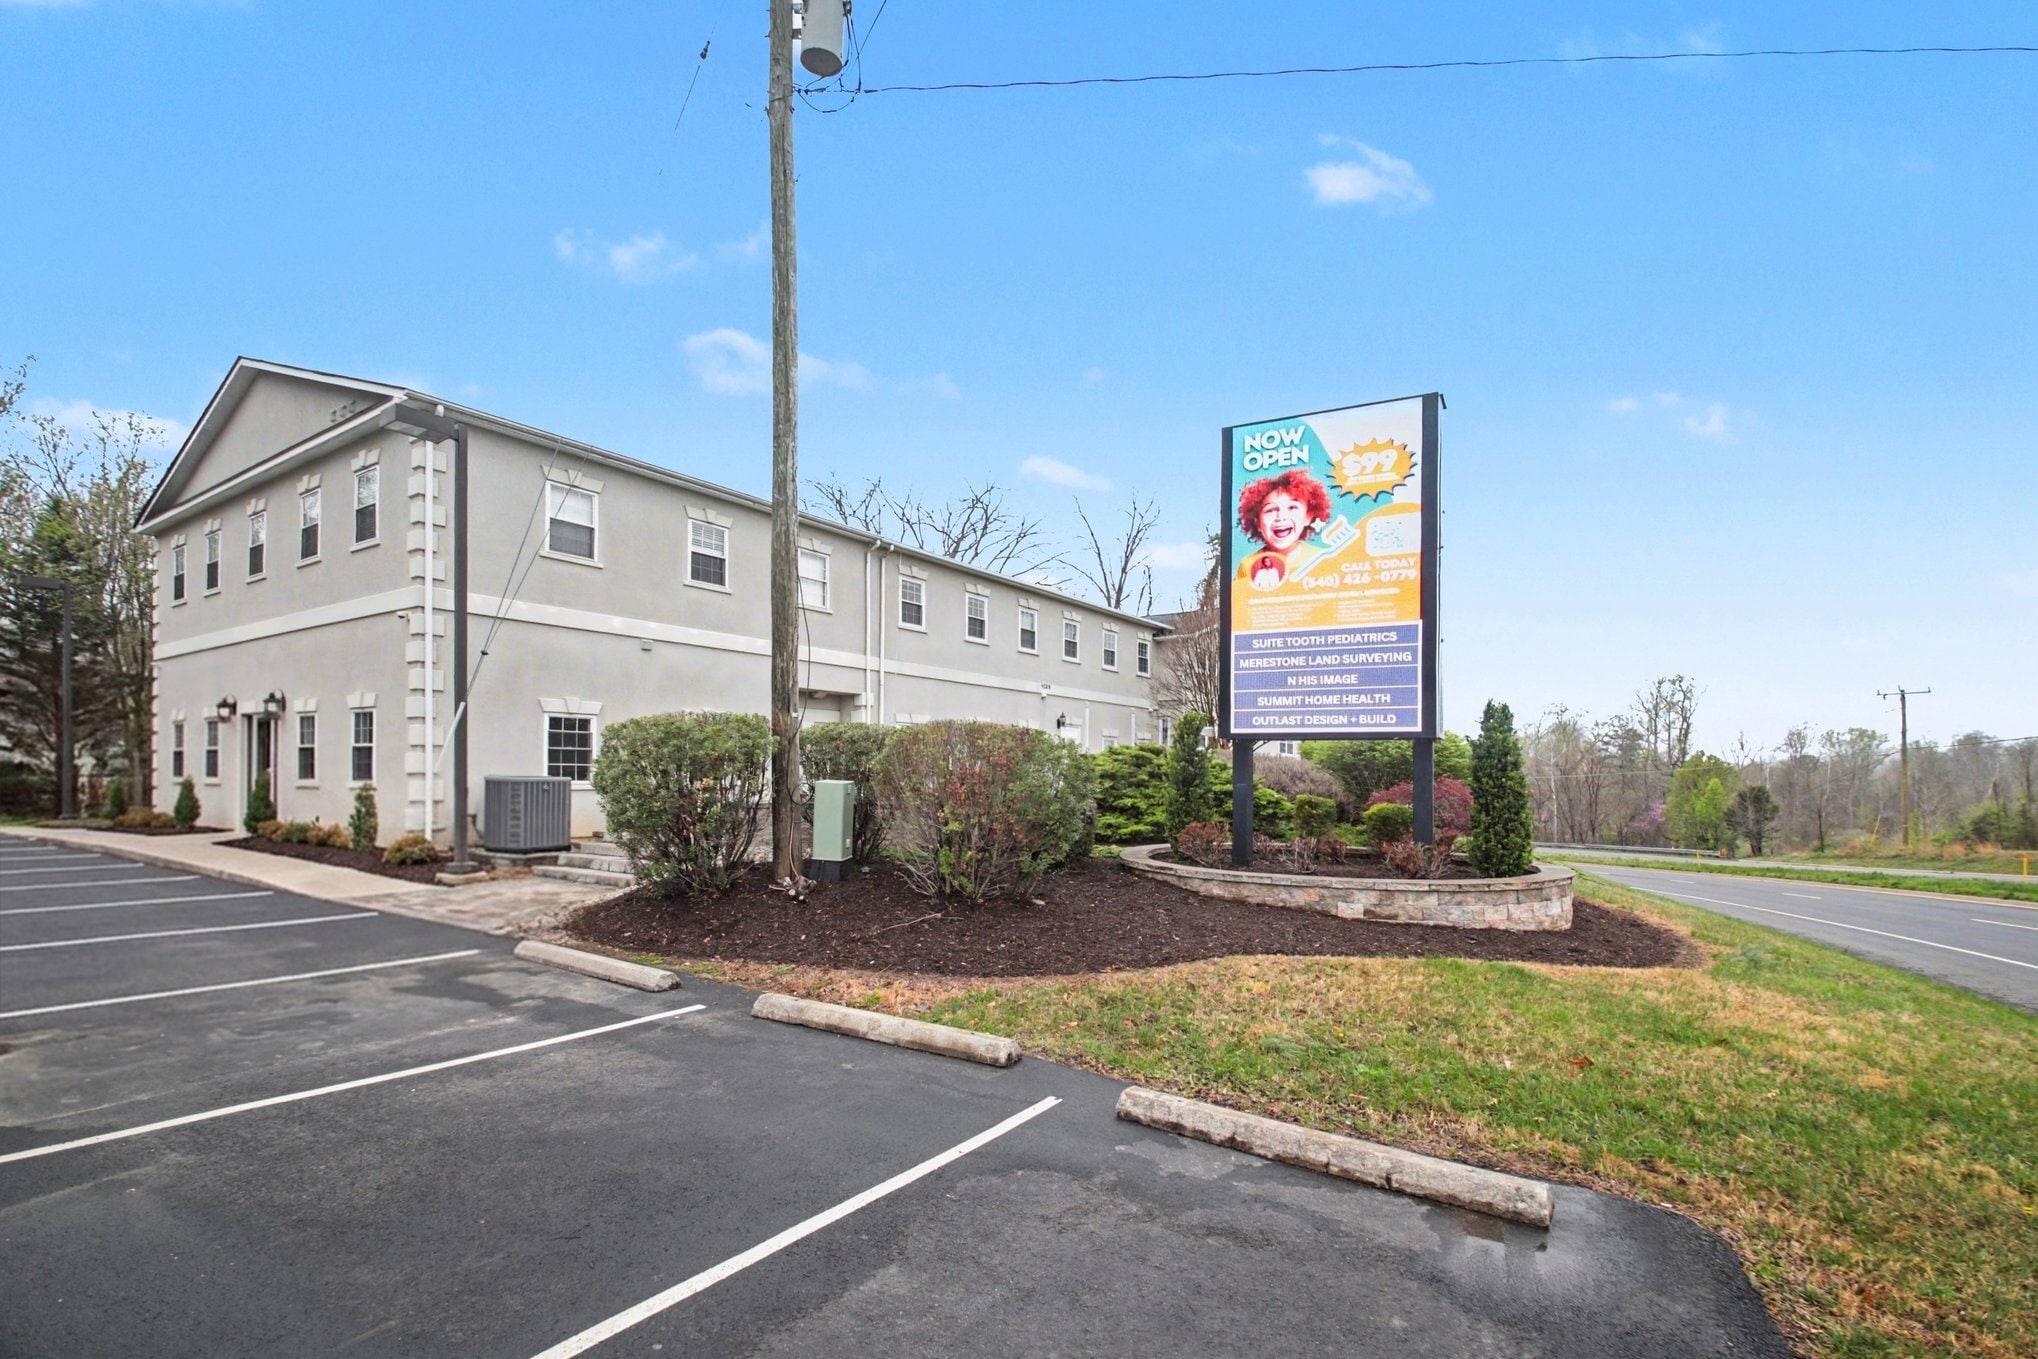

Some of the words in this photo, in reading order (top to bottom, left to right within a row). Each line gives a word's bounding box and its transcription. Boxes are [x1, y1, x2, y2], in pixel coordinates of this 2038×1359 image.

[1243, 425, 1306, 450] NOW
[1242, 445, 1310, 471] OPEN
[1341, 561, 1372, 572] CALL
[1374, 557, 1417, 569] TODAY
[1302, 573, 1340, 590] (540)
[1252, 638, 1285, 649] SUITE
[1287, 636, 1326, 647] TOOTH
[1327, 632, 1398, 645] PEDIATRICS
[1239, 656, 1307, 669] MERESTONE
[1308, 654, 1341, 666] LAND
[1342, 652, 1412, 665] SURVEYING
[1287, 676, 1297, 686] N
[1298, 675, 1318, 686] HIS
[1319, 674, 1359, 685] IMAGE
[1257, 696, 1304, 707] SUMMIT
[1304, 695, 1341, 706] HOME
[1342, 693, 1391, 705] HEALTH
[1252, 715, 1303, 727] OUTLAST
[1304, 715, 1348, 725] DESIGN
[1358, 714, 1397, 725] BUILD
